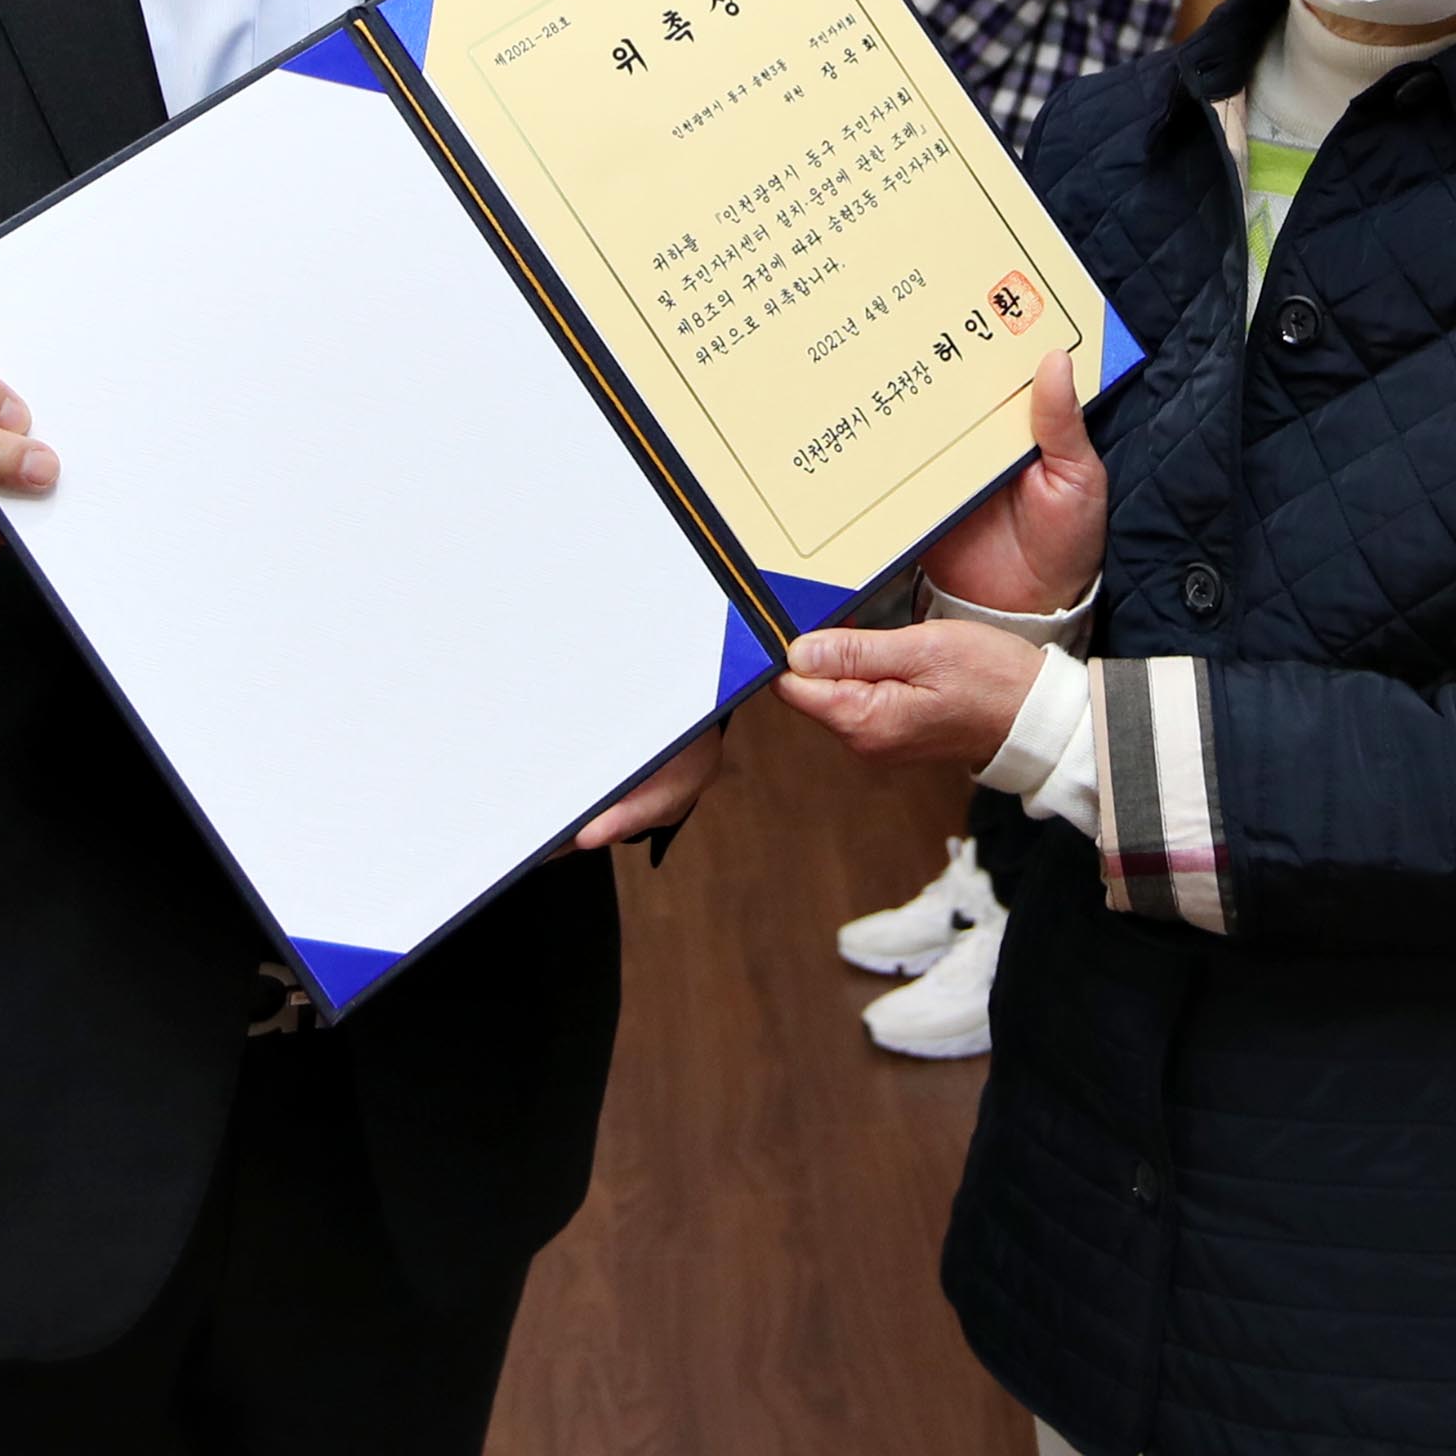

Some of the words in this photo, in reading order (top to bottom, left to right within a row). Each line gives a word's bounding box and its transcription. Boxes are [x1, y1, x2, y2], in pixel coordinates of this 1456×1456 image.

[611, 37, 649, 76] 위
[671, 99, 724, 140] 인천광역시
[727, 84, 748, 104] 동구
[808, 13, 857, 49] 주민자치회
[820, 60, 838, 80] 장
[652, 233, 700, 271] 귀하를
[805, 139, 836, 169] 동구
[841, 86, 914, 143] 주민자치회
[656, 289, 677, 312] 및
[681, 223, 772, 293] 주민자치센터
[855, 144, 887, 173] 관한
[676, 289, 736, 336] 제8조의
[741, 252, 788, 293] 규정에
[791, 228, 823, 256] 따라
[881, 137, 951, 193] 주민자치회
[695, 315, 761, 366] 위원으로
[763, 256, 846, 317] 위촉합니다.
[807, 316, 861, 364] 2021년
[864, 295, 890, 322] 4월
[891, 268, 927, 302] 20일
[792, 406, 872, 475] 인천광역시
[870, 359, 933, 417] 동구청장
[931, 331, 964, 363] 허
[964, 309, 994, 342] 인
